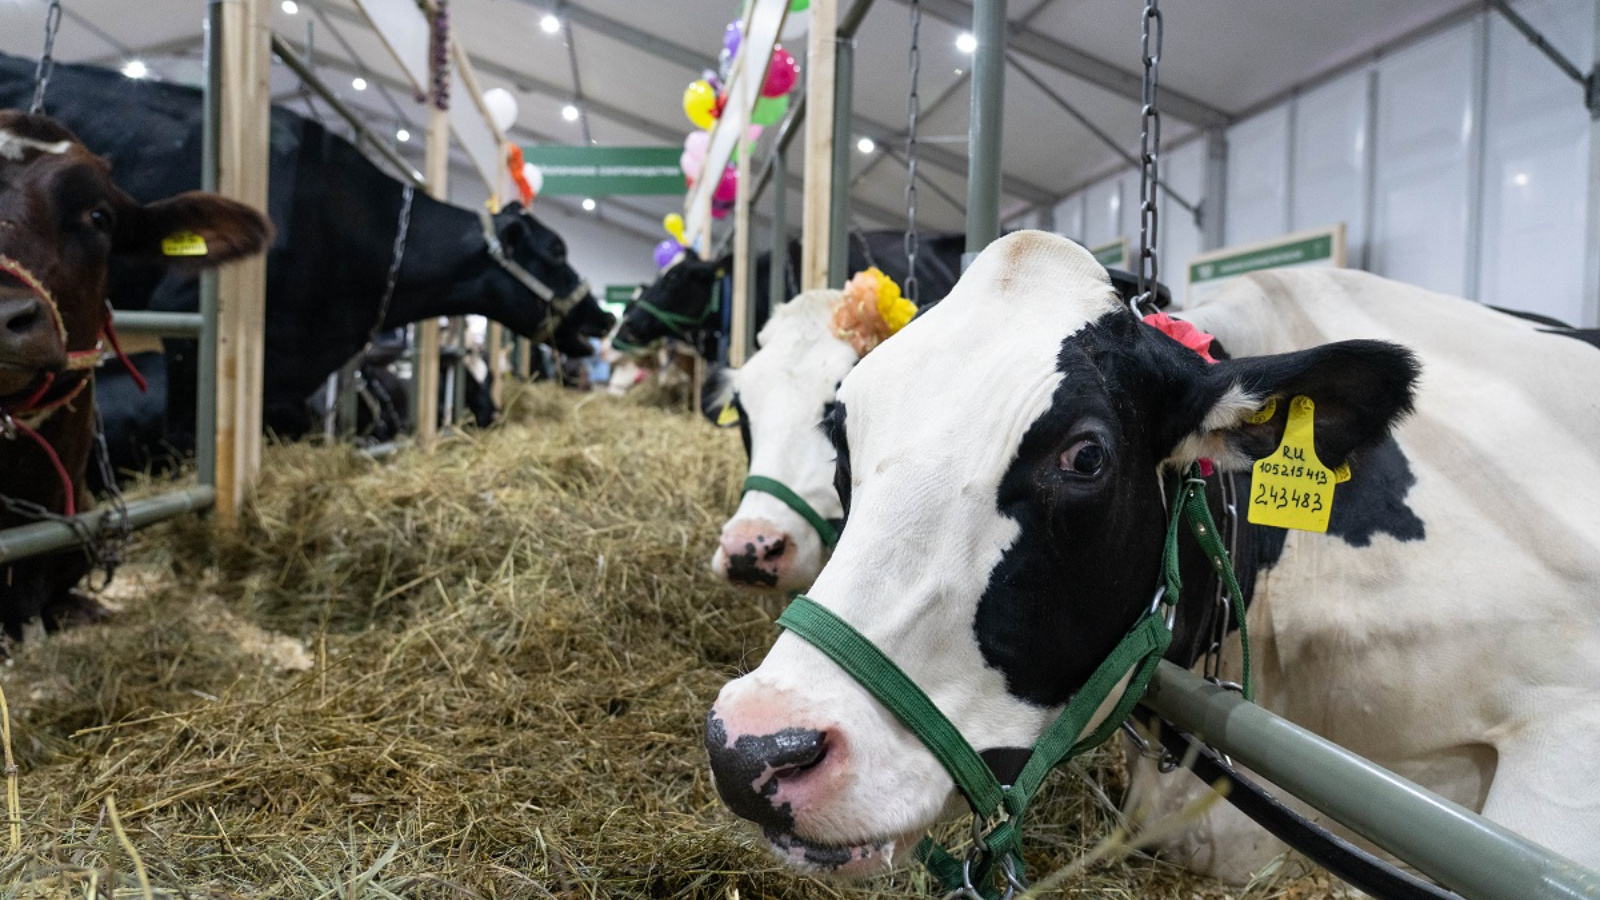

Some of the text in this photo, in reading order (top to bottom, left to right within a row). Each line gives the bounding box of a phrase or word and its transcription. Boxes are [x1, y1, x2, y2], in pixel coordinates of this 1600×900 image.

[1282, 445, 1305, 462] RU
[1259, 461, 1328, 485] 105215413
[1254, 483, 1323, 513] 243483
